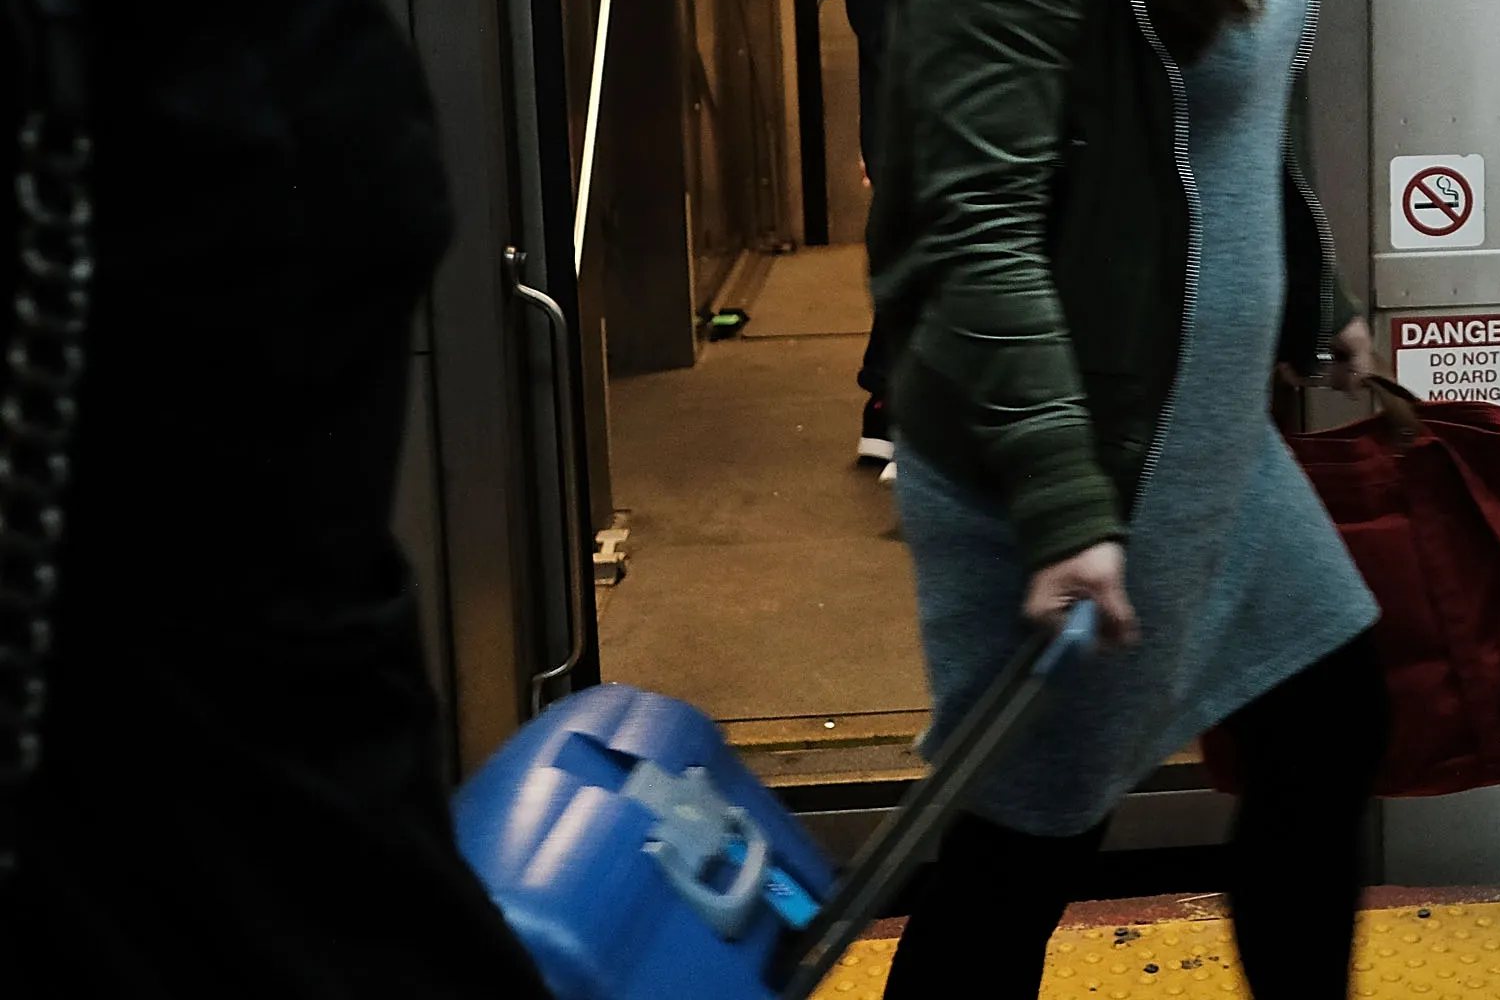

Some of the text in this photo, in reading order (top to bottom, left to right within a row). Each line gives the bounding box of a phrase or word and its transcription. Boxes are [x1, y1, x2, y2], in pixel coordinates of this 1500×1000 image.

[1430, 351, 1500, 367] DO NOT
[1433, 369, 1498, 385] BOARD
